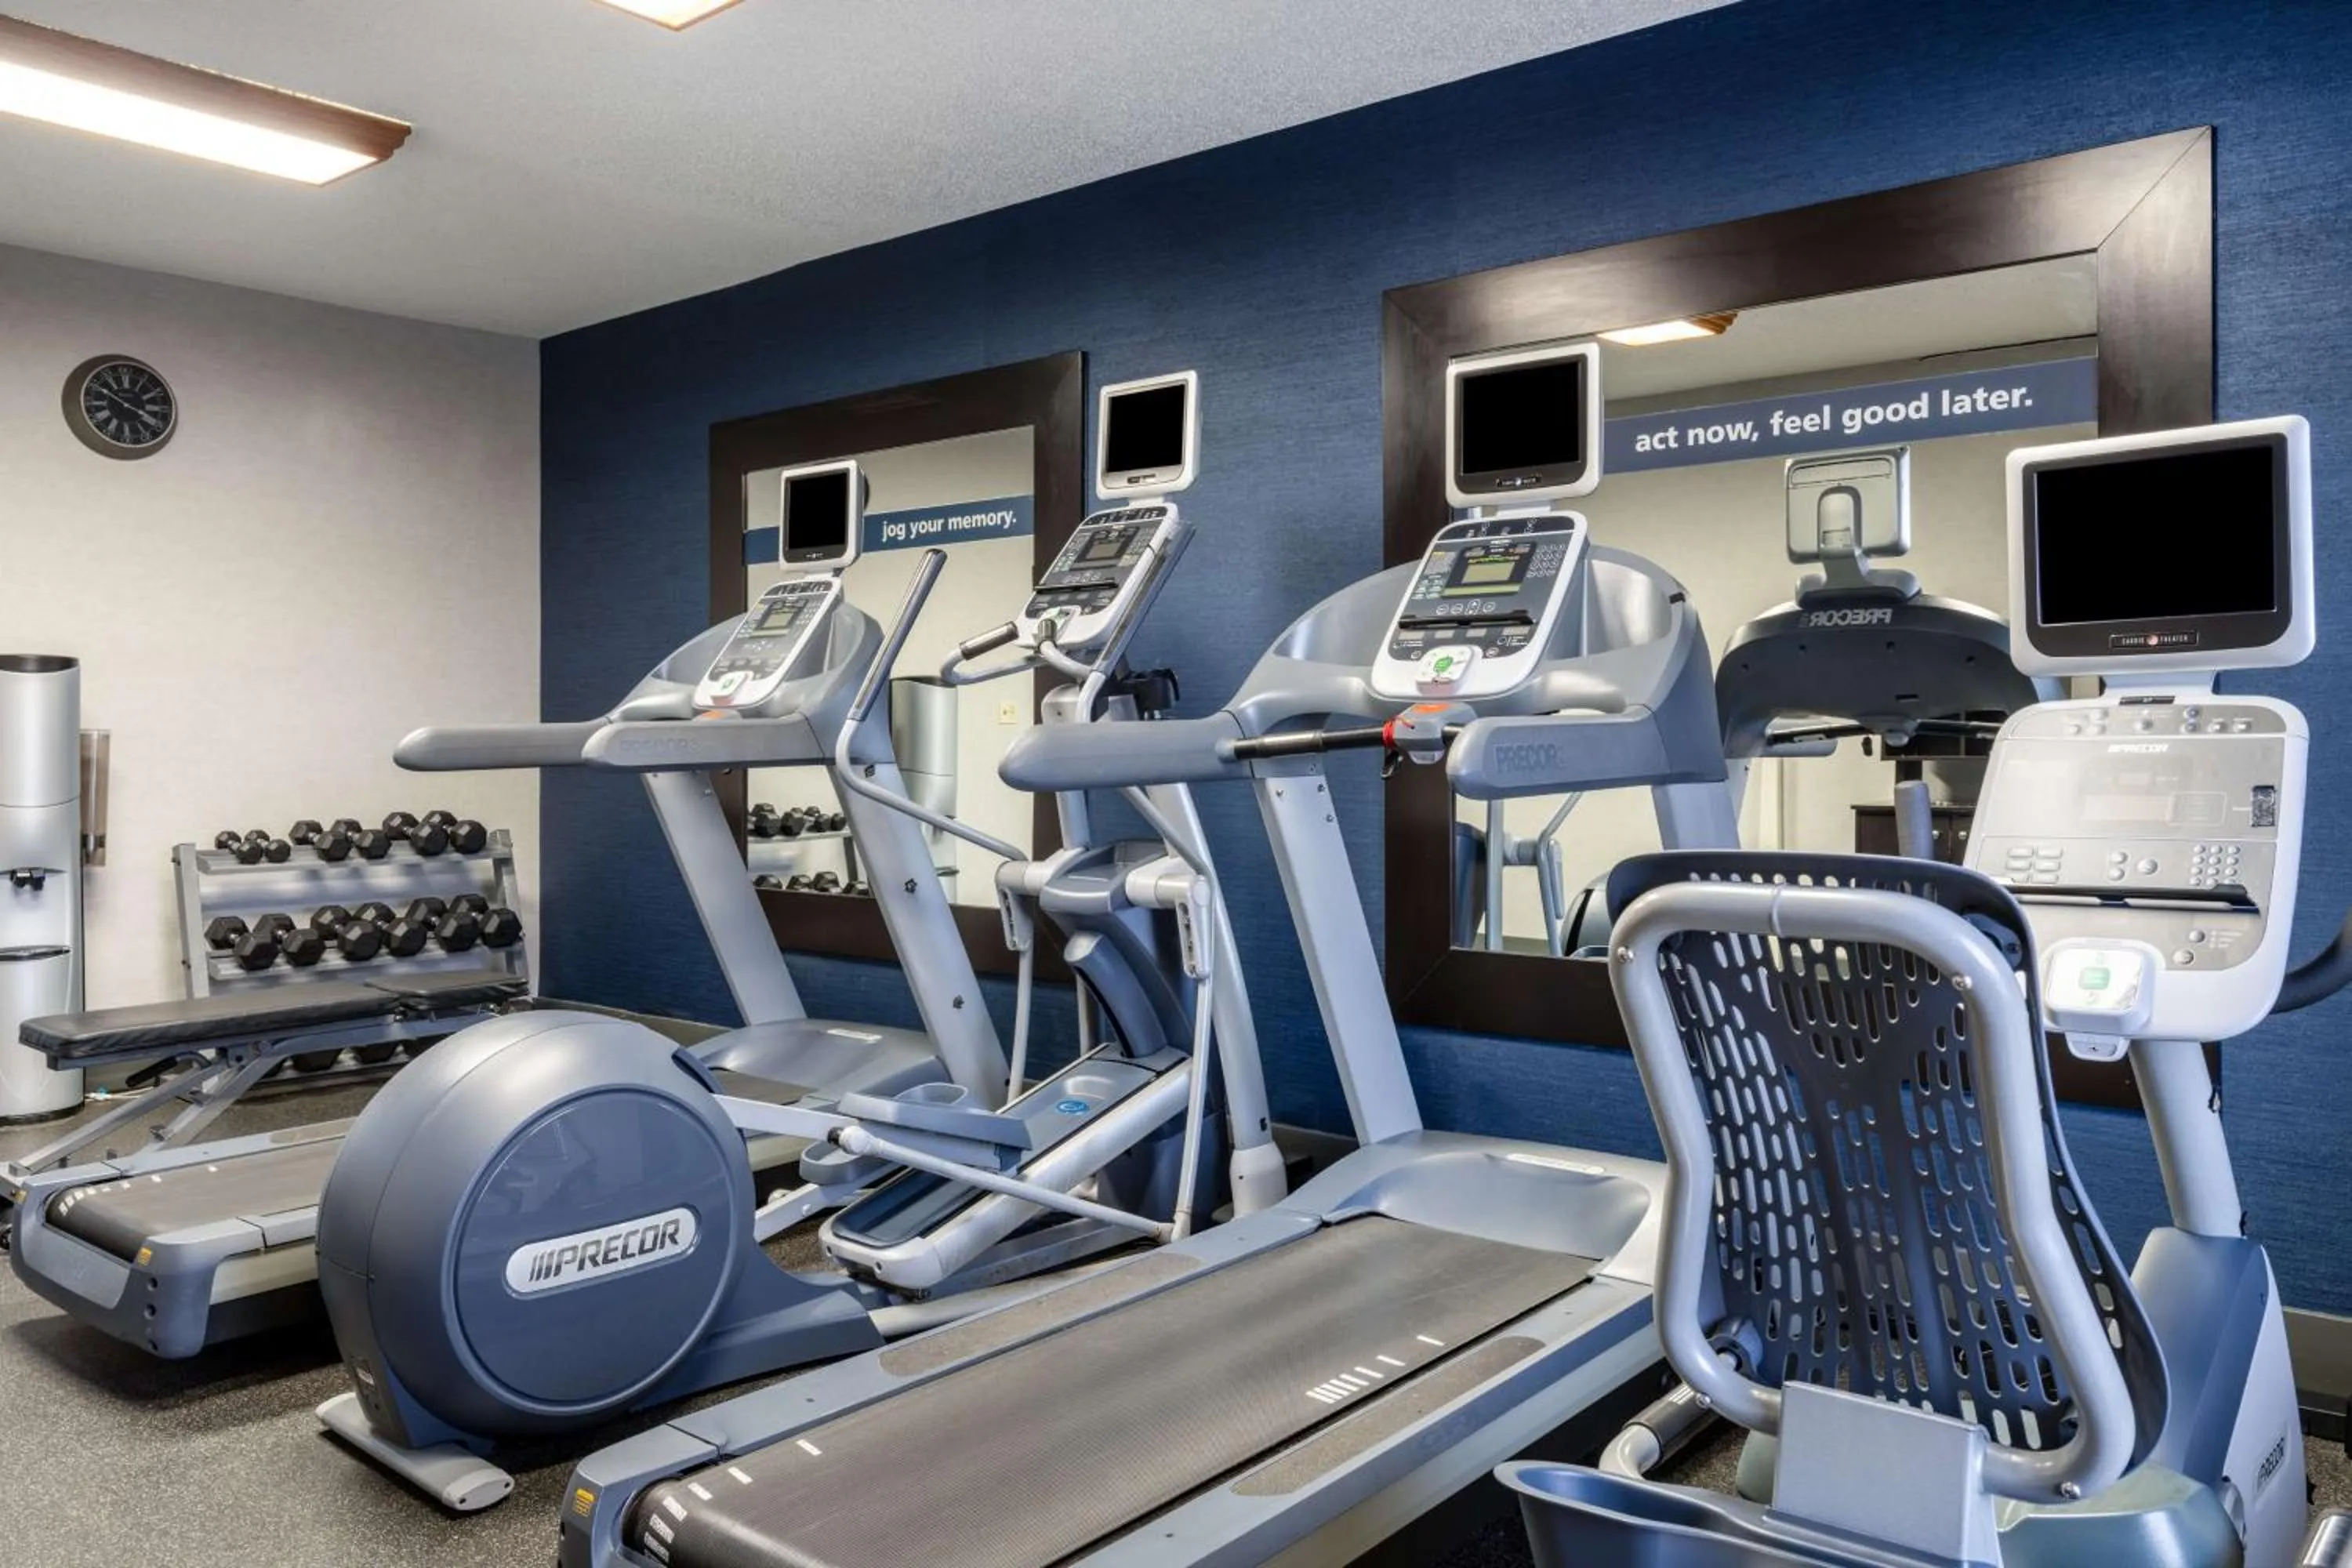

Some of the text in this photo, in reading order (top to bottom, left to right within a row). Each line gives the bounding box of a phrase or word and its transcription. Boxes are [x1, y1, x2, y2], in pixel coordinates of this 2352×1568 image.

[1635, 387, 2033, 452] act now, feel good later.
[881, 510, 1017, 543] jog your memory.
[1494, 744, 1557, 772] PRECOR
[548, 1218, 681, 1279] PRECOR
